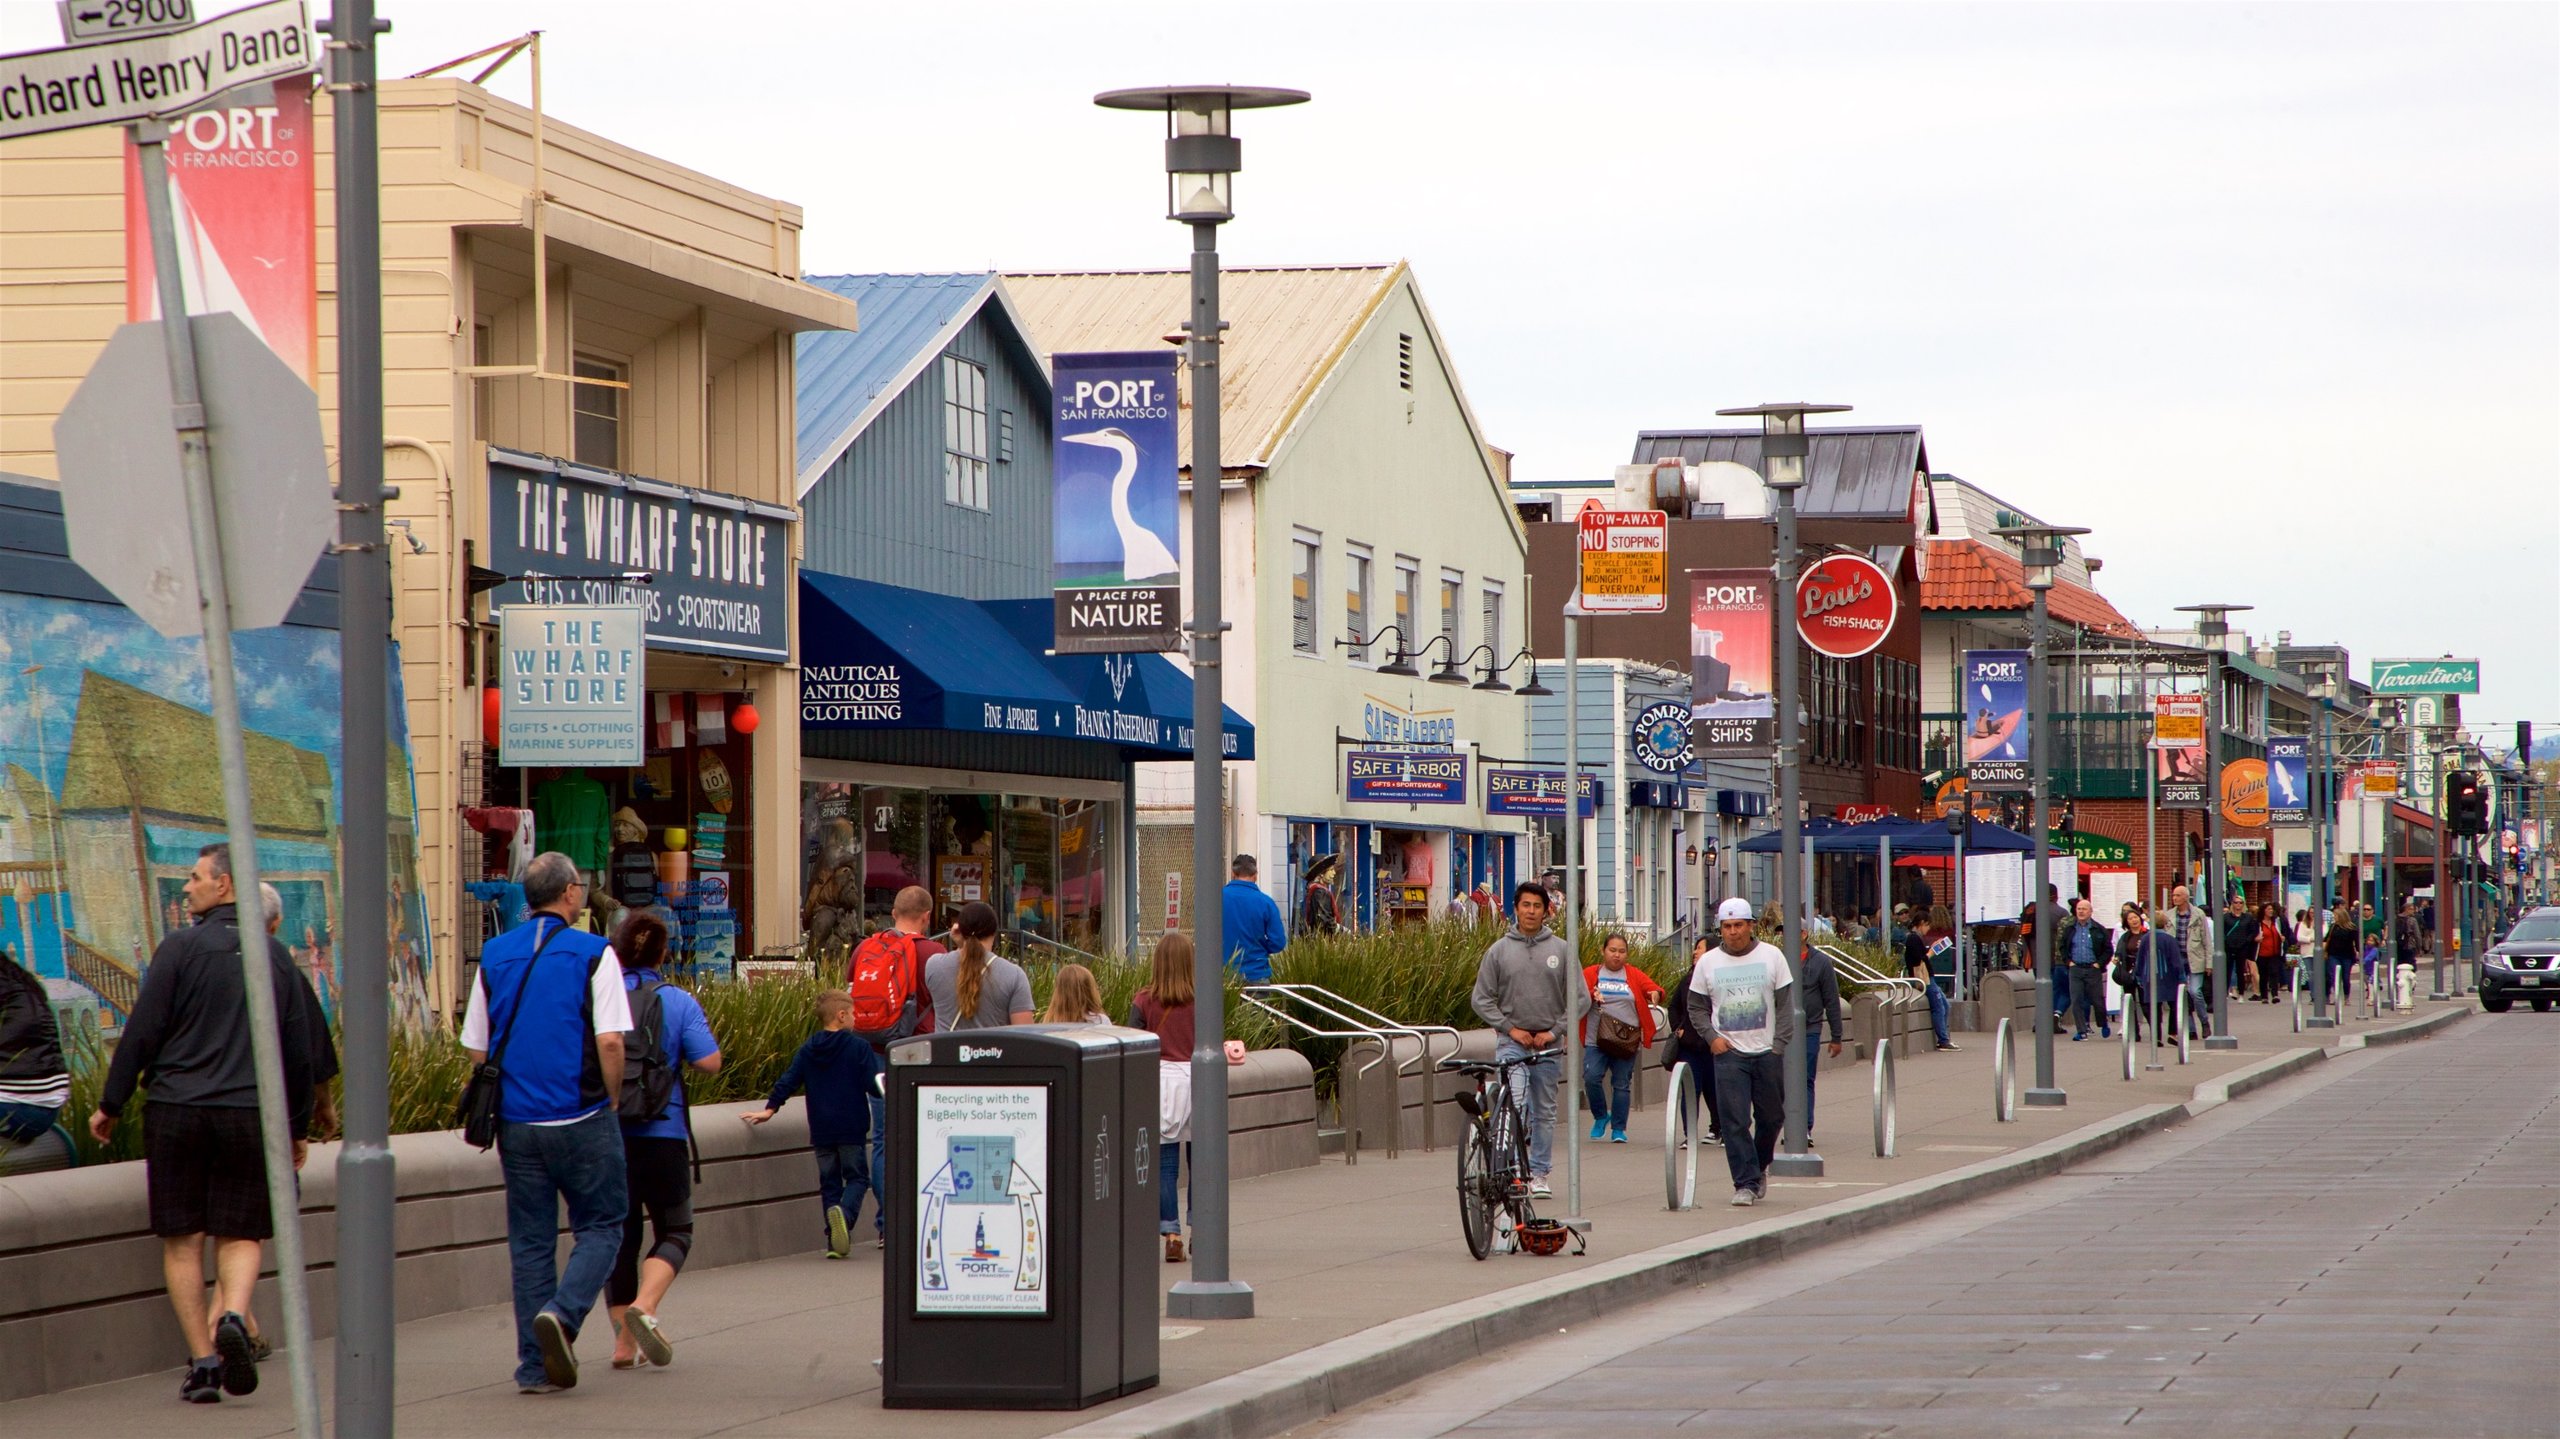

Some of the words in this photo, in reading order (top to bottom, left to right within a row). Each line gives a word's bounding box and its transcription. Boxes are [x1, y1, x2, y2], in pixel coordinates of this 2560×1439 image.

[106, 0, 188, 28] 2900
[0, 65, 106, 121] chard
[112, 50, 211, 103] Henry
[221, 24, 300, 72] Dana
[183, 150, 299, 168] FRANCISCO
[1062, 395, 1075, 403] THE
[1075, 380, 1155, 409] PORT
[1154, 393, 1165, 402] OF
[1061, 409, 1087, 420] SAN
[1091, 407, 1168, 420] FRANCISCO
[1588, 513, 1659, 526] TOW-AWAY
[517, 479, 568, 555] THE
[583, 492, 678, 573] WHARF
[691, 512, 766, 587] STORE
[1583, 528, 1605, 550] NO
[1611, 536, 1660, 549] STOPPING
[1588, 552, 1612, 560] EXCEPT
[1616, 552, 1658, 560] COMMERCIAL
[1594, 559, 1620, 567] VEHICLE
[1625, 559, 1654, 567] LOADING
[1585, 574, 1623, 584] MIDNIGHT
[1075, 592, 1083, 601] A
[1089, 590, 1127, 601] PLACE
[1132, 590, 1156, 600] FOR
[1599, 584, 1646, 594] EVERYDAY
[1706, 586, 1757, 604] PORT
[1803, 571, 1873, 618] Lou's
[522, 569, 563, 605] GIFTS
[677, 594, 761, 635] SPORTSWEAR
[1716, 603, 1765, 611] FRANCISCO
[1071, 603, 1162, 628] NATURE
[1823, 615, 1846, 628] FISH
[1848, 617, 1884, 631] SHACK
[543, 620, 603, 646] THE
[512, 649, 632, 676] WHARF
[1978, 662, 2017, 676] PORT
[803, 665, 900, 681] NAUTICAL
[2374, 662, 2475, 691] Tarantino's
[517, 678, 627, 705] STORE
[803, 683, 900, 701] ANTIQUES
[802, 704, 901, 721] CLOTHING
[2157, 703, 2169, 715] NO
[508, 722, 549, 734] GIFTS
[561, 722, 634, 734] CLOTHING
[984, 702, 1002, 729] FINE
[1006, 705, 1040, 731] APPAREL
[1075, 705, 1111, 741] FRANK'S
[1113, 710, 1159, 745] FISHERMAN
[1178, 725, 1195, 749] NAUT
[1222, 732, 1238, 755] QUES
[1365, 703, 1399, 752] SAFE
[1403, 718, 1455, 753] HARBOR
[1711, 727, 1753, 743] SHIPS
[508, 738, 564, 750] MARINE
[567, 738, 634, 750] SUPPLIES
[2275, 745, 2300, 754] PORT
[1637, 743, 1693, 772] GROTTO
[1352, 760, 1392, 776] SAFE
[1397, 760, 1461, 777] HARBOR
[1971, 768, 2025, 780] BOATING
[2354, 769, 2364, 777] PO
[706, 773, 726, 789] 101
[1492, 776, 1527, 791] SAFE
[2166, 791, 2200, 800] SPORTS
[2272, 813, 2304, 821] FISHING
[2224, 840, 2246, 848] Scoma
[2248, 840, 2263, 848] Way
[1598, 982, 1619, 991] urley
[1717, 974, 1766, 985] AEROPOSTALE
[1727, 986, 1756, 997] NYC
[959, 1045, 1003, 1062] Bigbelly
[935, 1094, 983, 1105] Recycling
[986, 1093, 1008, 1104] with
[1012, 1093, 1030, 1104] the
[927, 1110, 967, 1122] BigBelly
[971, 1110, 997, 1120] Solar
[1000, 1110, 1037, 1122] System
[961, 1263, 998, 1273] PORT
[924, 1294, 954, 1302] THANKS
[955, 1294, 971, 1302] FOR
[973, 1294, 1004, 1302] KEEPING
[1006, 1294, 1013, 1302] IT
[1015, 1294, 1039, 1302] CLEAN
